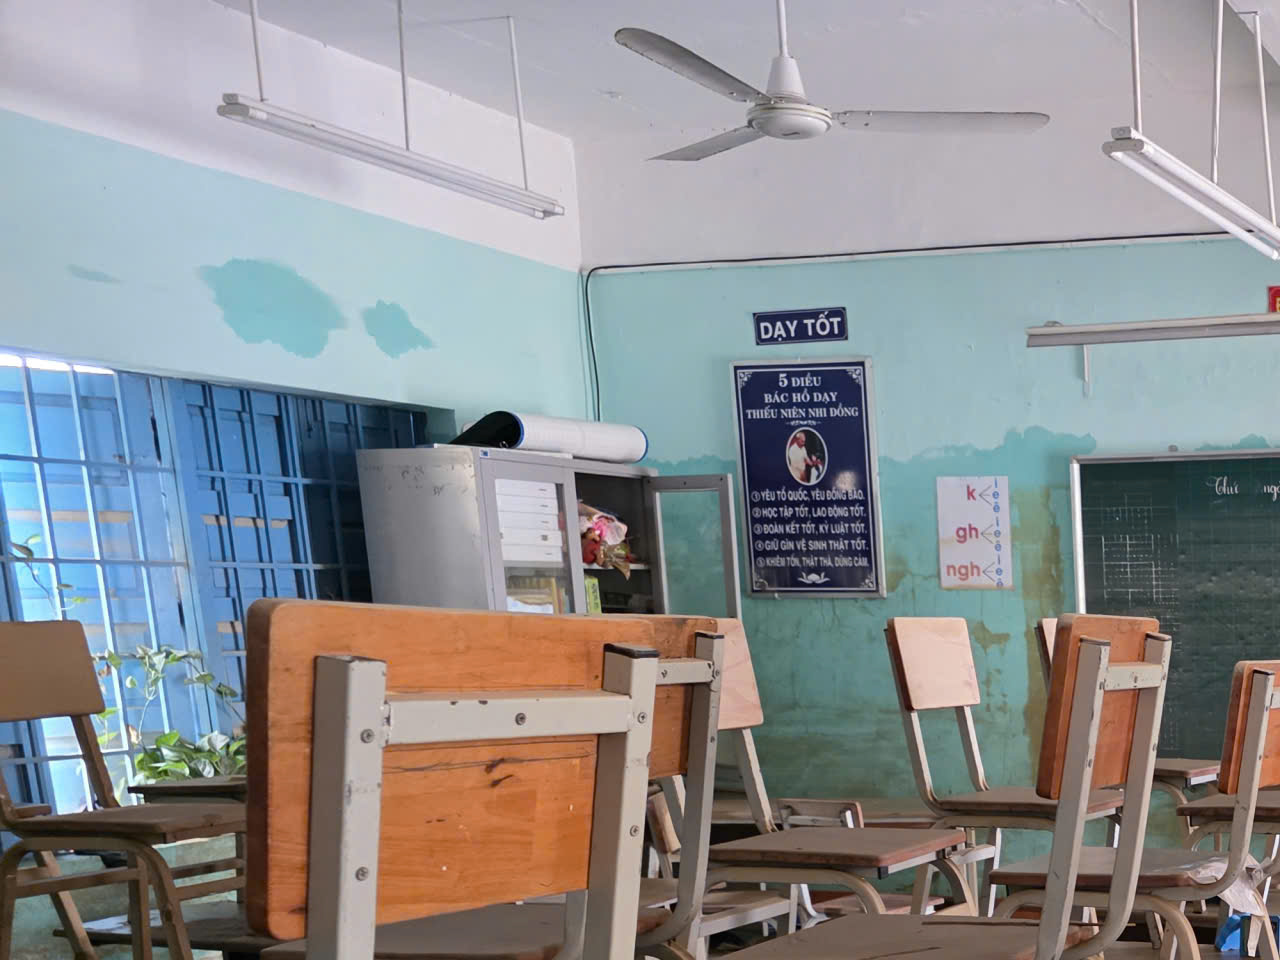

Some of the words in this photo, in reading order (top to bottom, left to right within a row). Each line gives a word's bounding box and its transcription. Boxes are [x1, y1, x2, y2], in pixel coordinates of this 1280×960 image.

[760, 320, 798, 341] DẠY
[803, 311, 841, 336] TỐT
[779, 373, 788, 387] 5
[764, 391, 788, 403] BÁC
[792, 388, 810, 402] HỒ
[813, 392, 838, 404] DẠY
[746, 405, 778, 419] THIẾU
[780, 406, 806, 418] NIÊN
[808, 408, 828, 418] NHI
[830, 403, 859, 417] ĐỒNG
[761, 489, 775, 500] YÊU
[787, 487, 810, 501] QUỐC,
[811, 488, 825, 500] YÊU
[826, 487, 847, 500] ĐỒNG
[967, 484, 976, 501] k
[1206, 476, 1239, 496] Thứ
[992, 490, 1000, 499] e
[762, 507, 778, 519] HỌC
[779, 505, 794, 519] TẬP
[795, 504, 811, 518] TỐT,
[812, 507, 827, 517] LAO
[828, 505, 849, 518] ĐỘNG
[849, 503, 867, 517] TỐT.
[763, 521, 784, 534] ĐOÀN
[785, 520, 800, 534] KẾT
[801, 520, 819, 535] TỐT,
[831, 521, 850, 535] LUẬT
[851, 520, 868, 534] TỐT.
[956, 523, 979, 544] gh
[764, 538, 779, 551] GIỮ
[780, 538, 794, 550] GÌN
[796, 538, 807, 552] VỆ
[808, 541, 827, 550] SINH
[829, 538, 850, 552] THẬT
[851, 537, 869, 550] TỐT.
[946, 561, 981, 581] ngh
